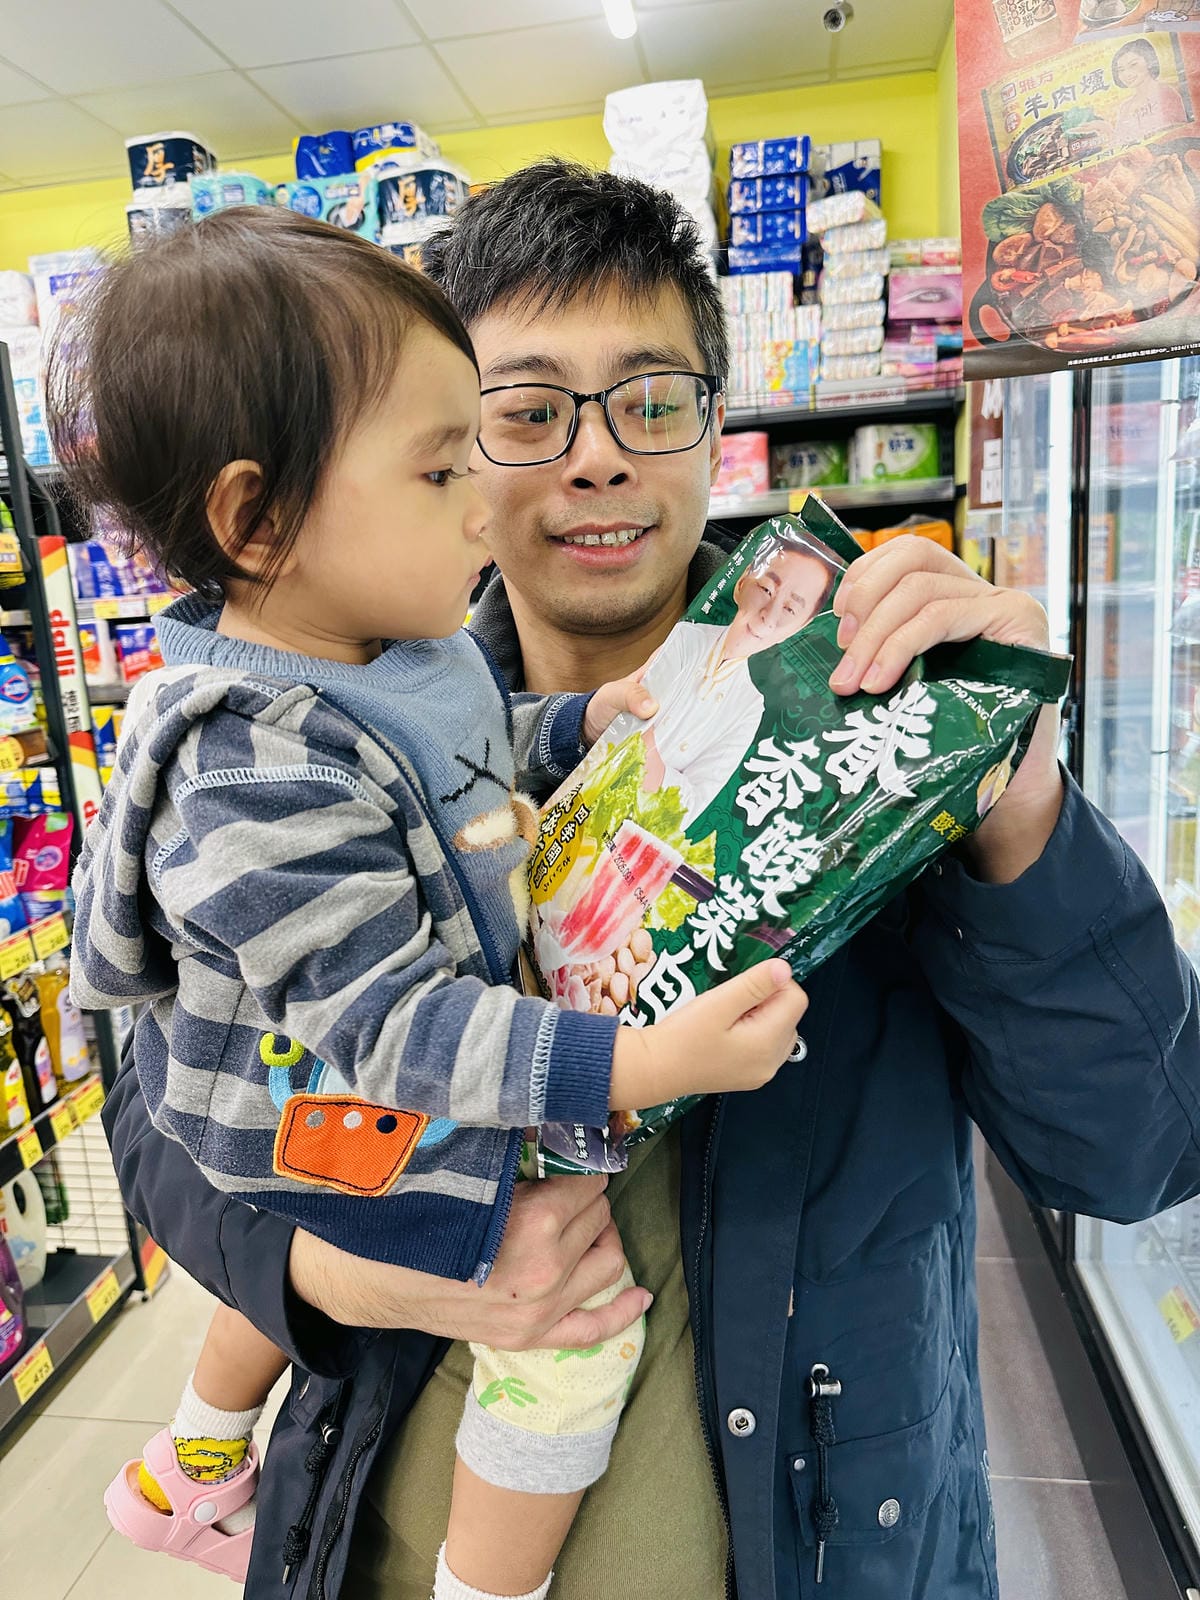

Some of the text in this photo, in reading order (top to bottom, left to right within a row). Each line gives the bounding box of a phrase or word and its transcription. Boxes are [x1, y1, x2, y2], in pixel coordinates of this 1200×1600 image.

[1024, 69, 1112, 119] 羊肉爐
[49, 609, 76, 677] dalli
[964, 698, 990, 721] FANG
